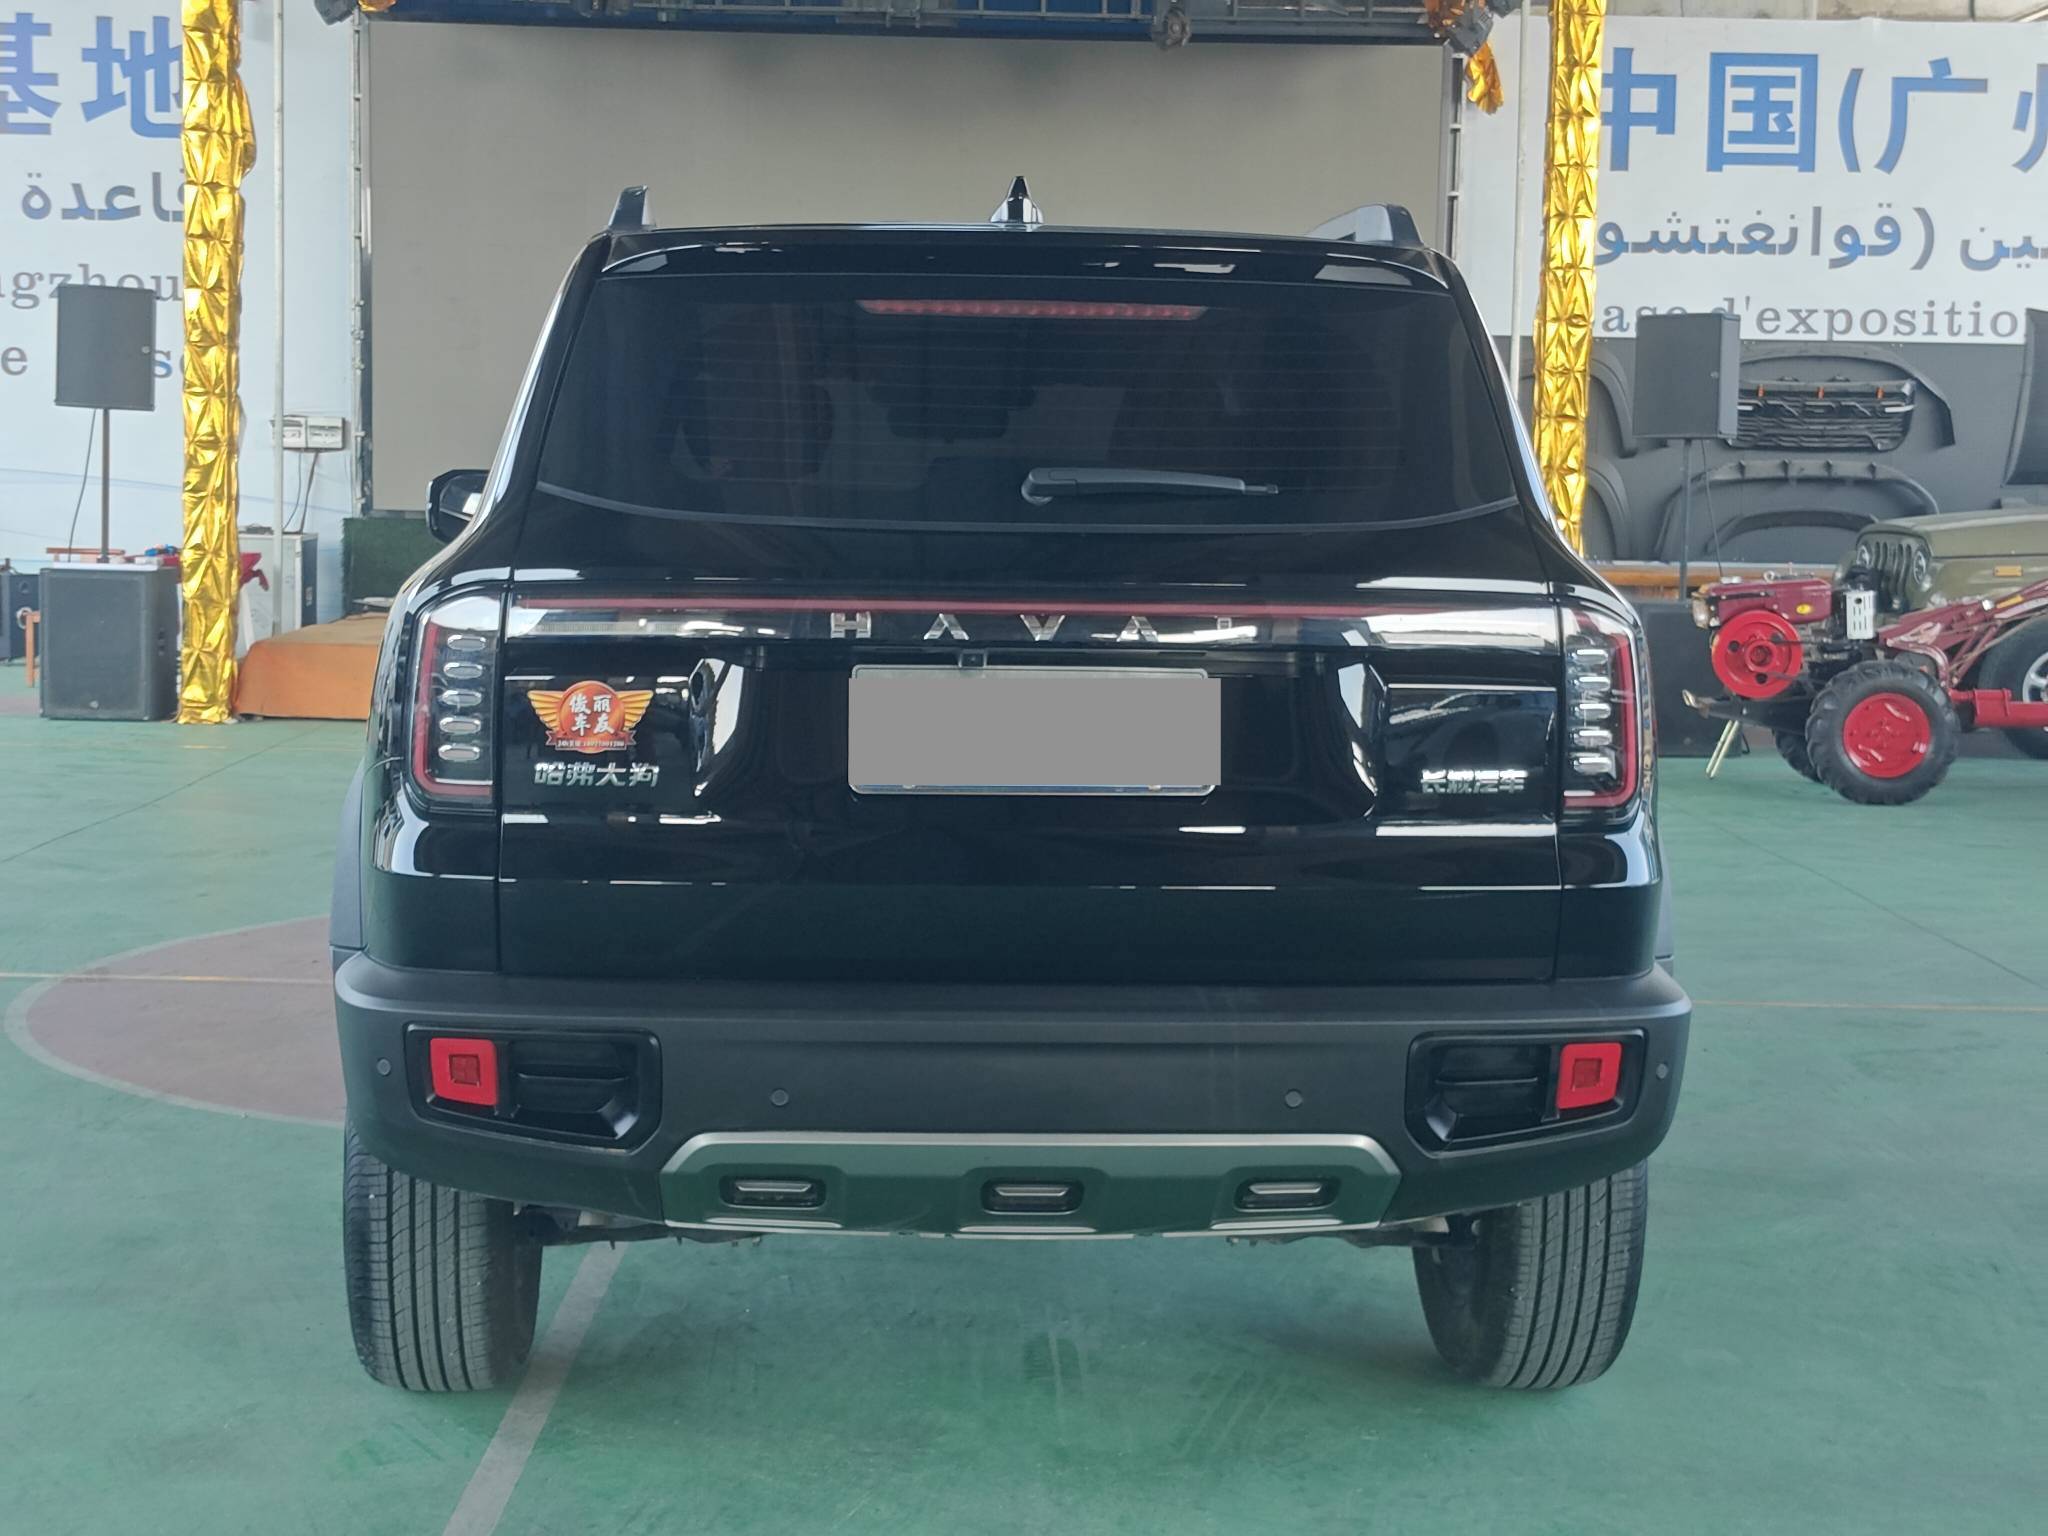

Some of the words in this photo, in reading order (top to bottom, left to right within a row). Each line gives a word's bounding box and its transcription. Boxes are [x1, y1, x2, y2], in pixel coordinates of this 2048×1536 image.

[0, 12, 182, 138] 基地
[21, 170, 184, 222] اعدة
[0, 263, 183, 310] gzhou
